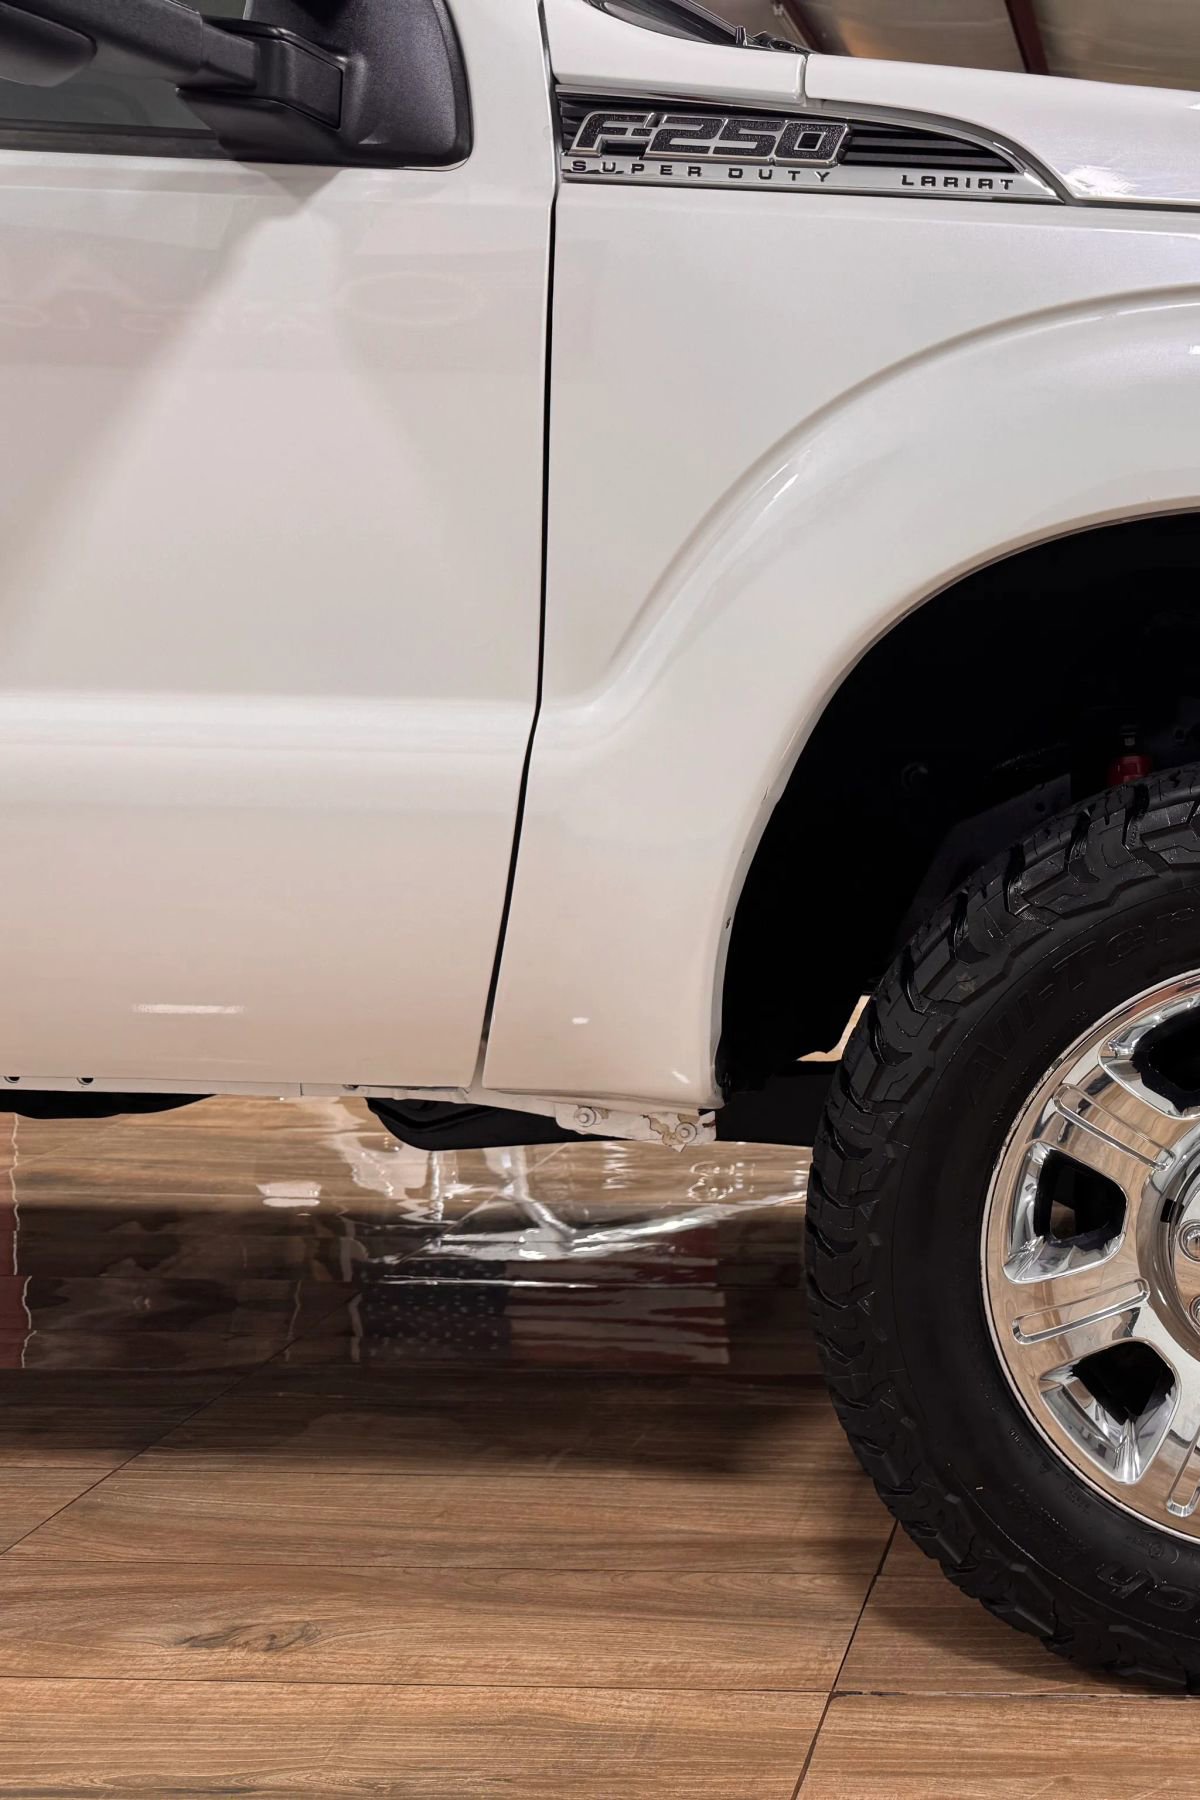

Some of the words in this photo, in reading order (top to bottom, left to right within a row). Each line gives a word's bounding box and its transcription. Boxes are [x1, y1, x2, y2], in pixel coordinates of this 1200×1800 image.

[569, 111, 848, 167] F-250
[571, 160, 702, 178] SUPER
[727, 167, 832, 183] DUTY
[901, 174, 1014, 190] LARIAT
